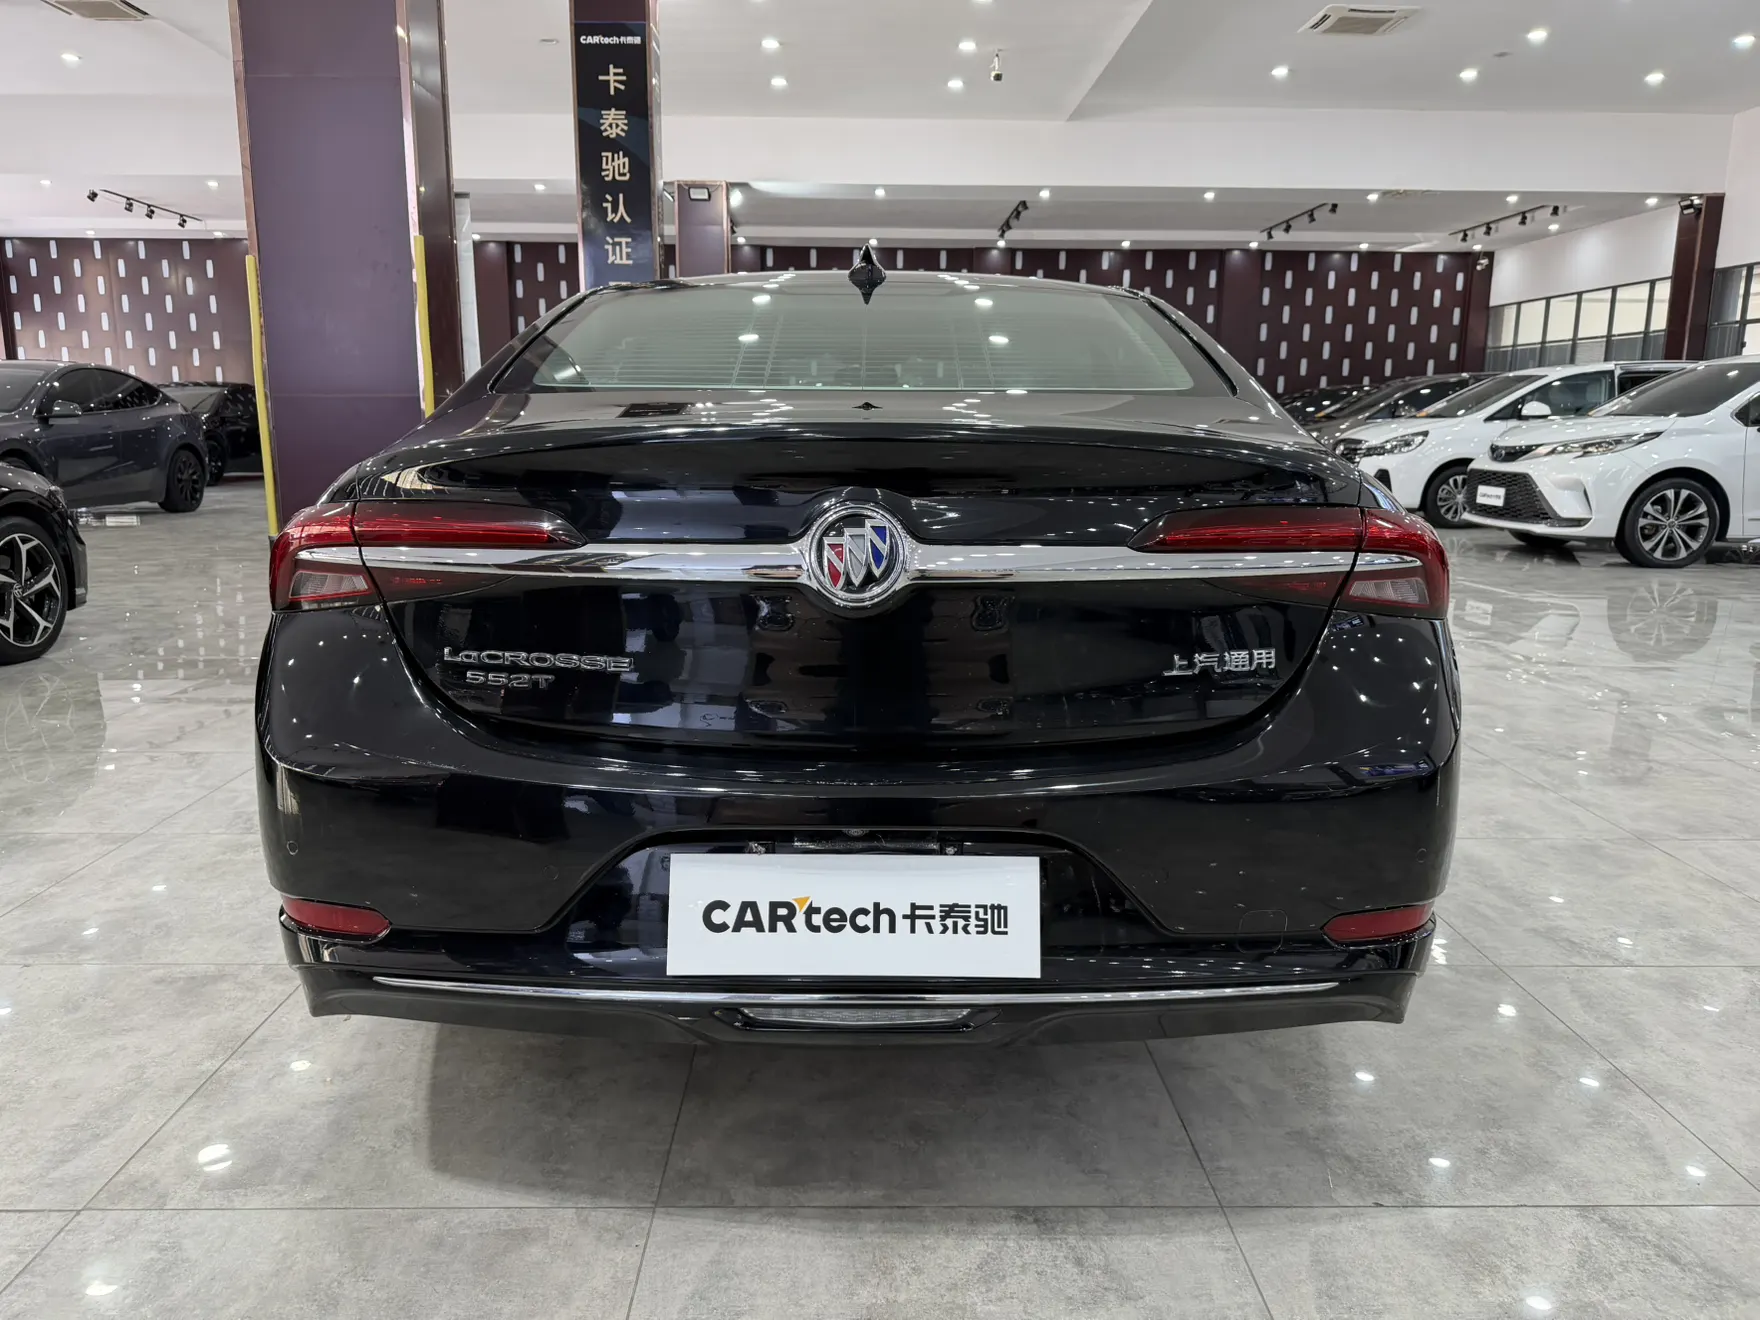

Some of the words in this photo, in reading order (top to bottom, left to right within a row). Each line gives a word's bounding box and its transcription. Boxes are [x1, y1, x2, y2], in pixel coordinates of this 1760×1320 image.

[598, 64, 634, 285] 卡泰驰认证
[1163, 648, 1276, 676] 上汽通用
[465, 670, 555, 689] 552T
